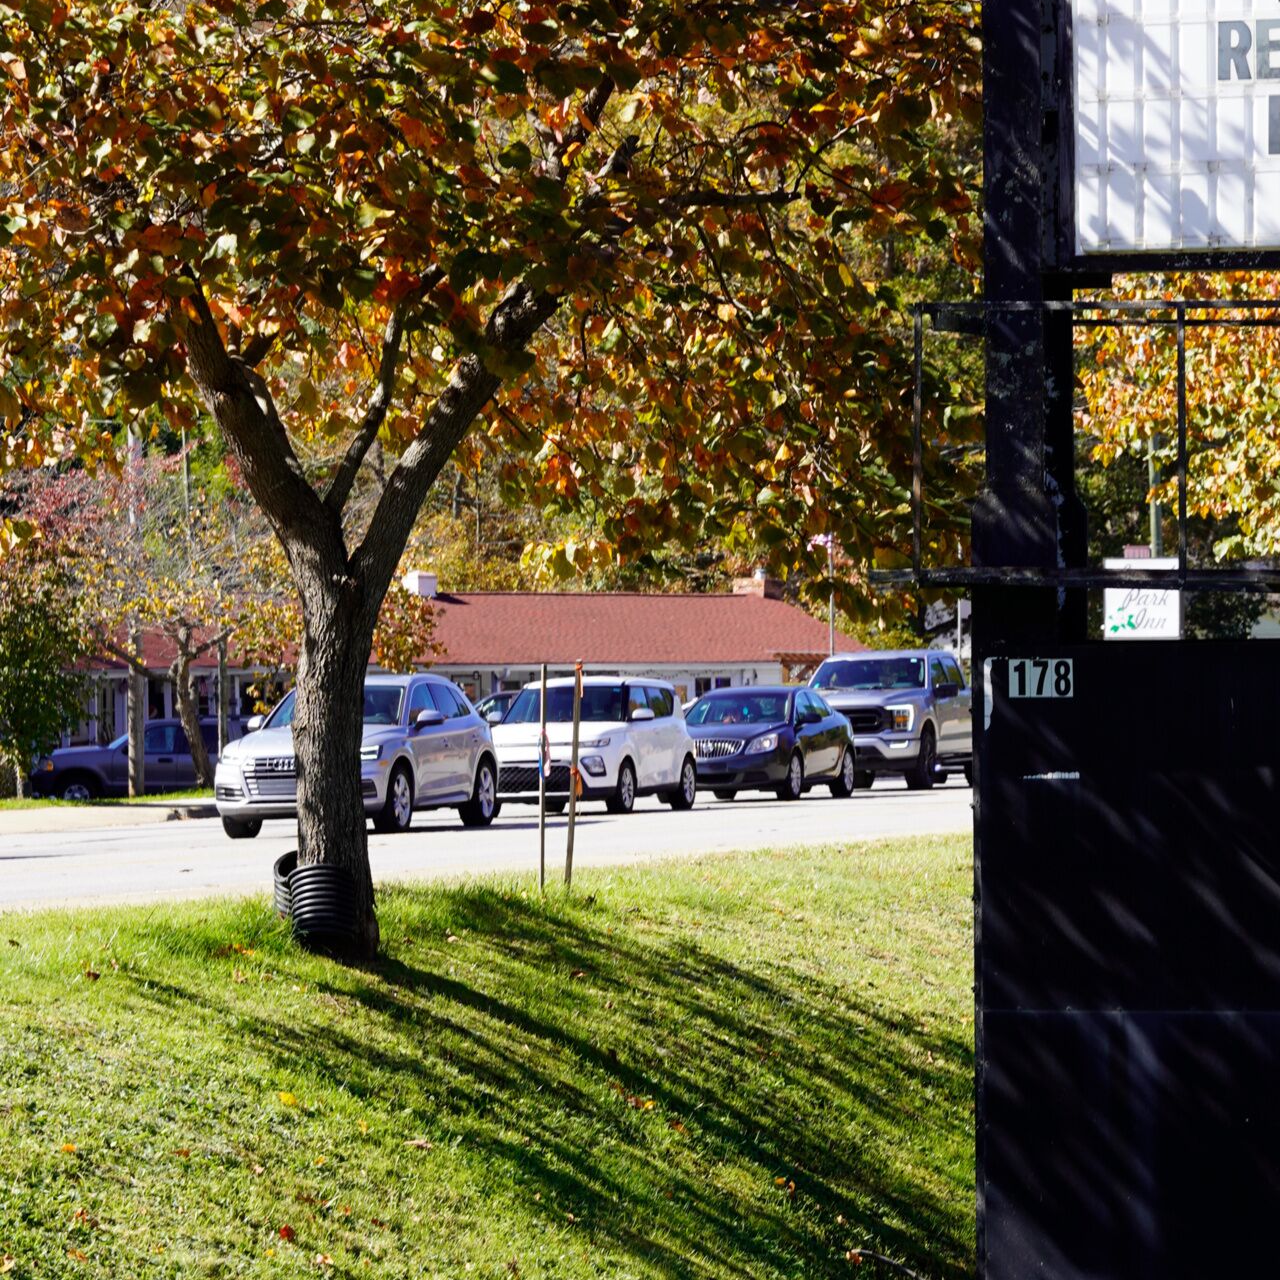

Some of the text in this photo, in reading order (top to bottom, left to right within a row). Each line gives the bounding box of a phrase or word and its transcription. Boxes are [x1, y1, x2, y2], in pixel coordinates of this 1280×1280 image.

[1123, 588, 1168, 609] Park
[1134, 608, 1166, 629] Inn
[1013, 660, 1071, 696] 178
